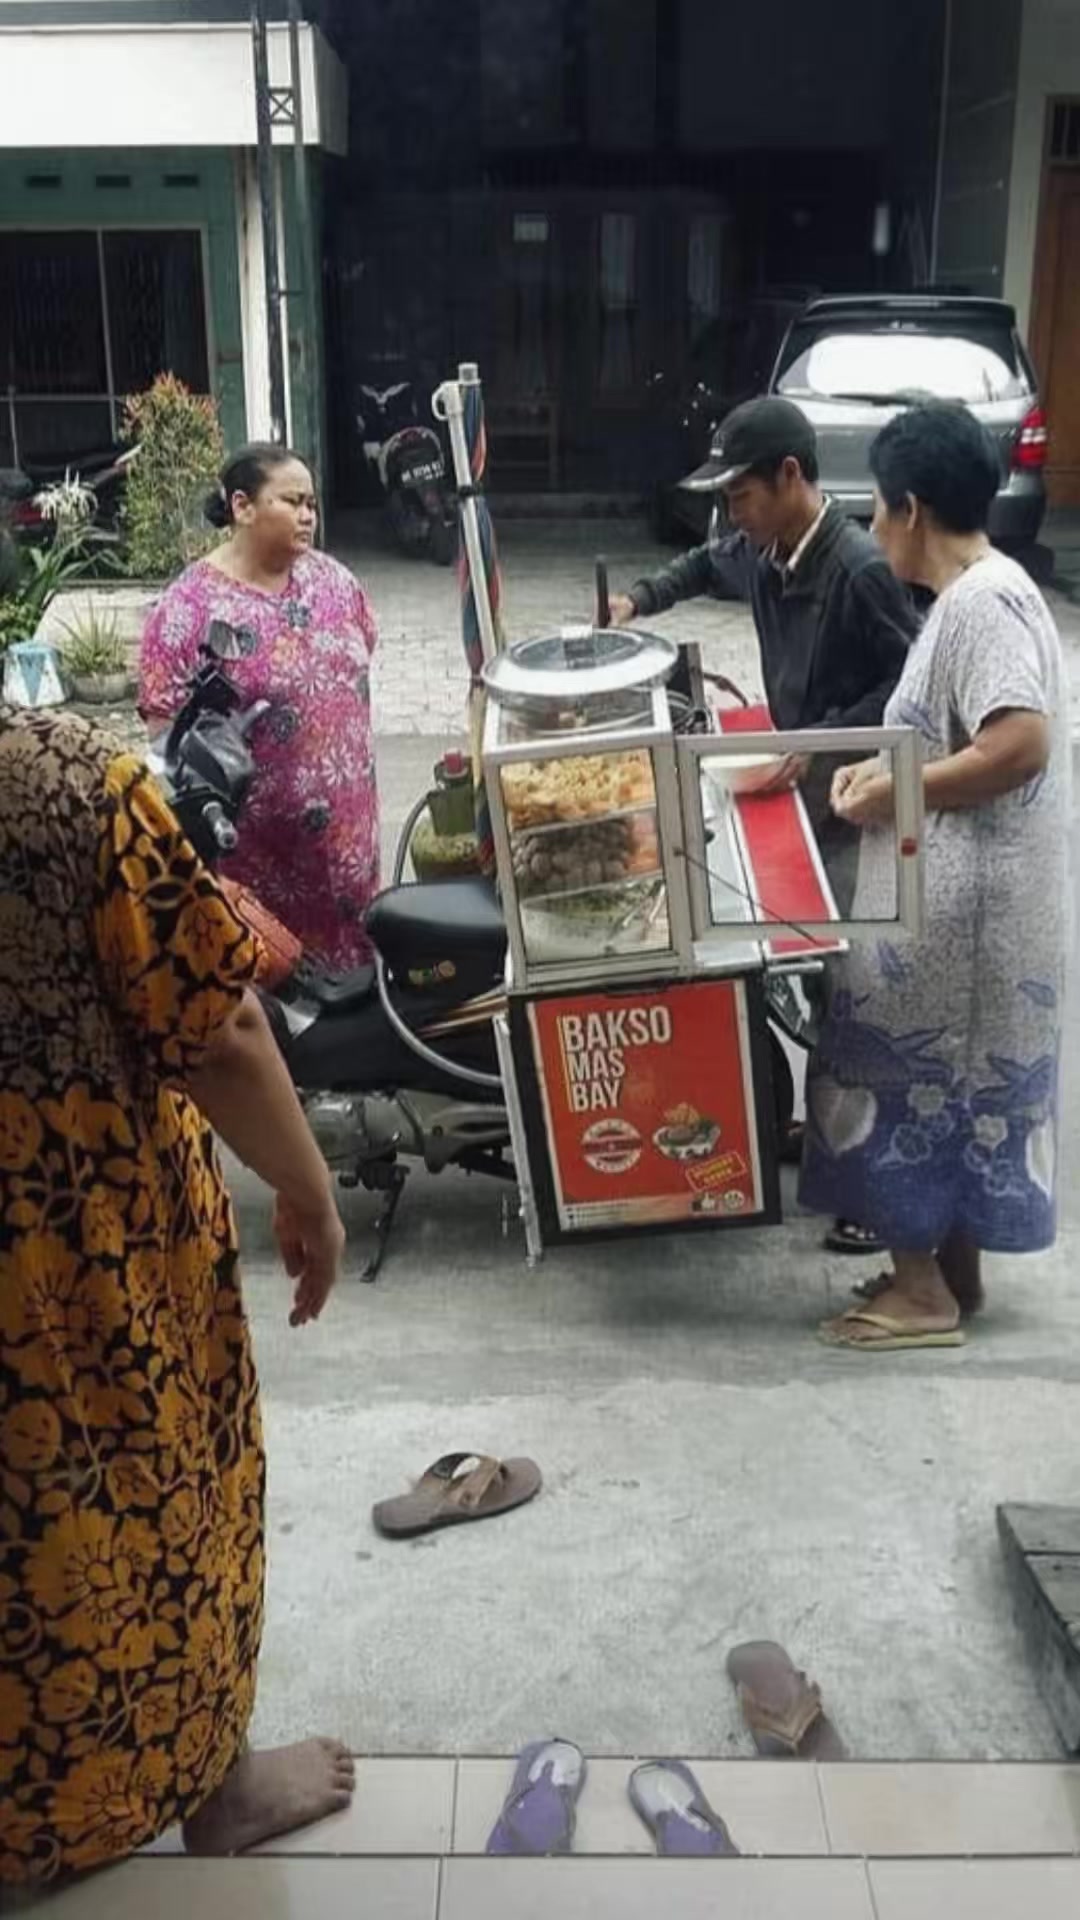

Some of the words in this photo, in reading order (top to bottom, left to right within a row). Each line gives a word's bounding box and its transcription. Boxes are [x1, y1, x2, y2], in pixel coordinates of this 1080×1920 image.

[562, 1005, 672, 1052] BAKSO
[567, 1048, 626, 1082] MAS
[572, 1079, 620, 1112] BAY
